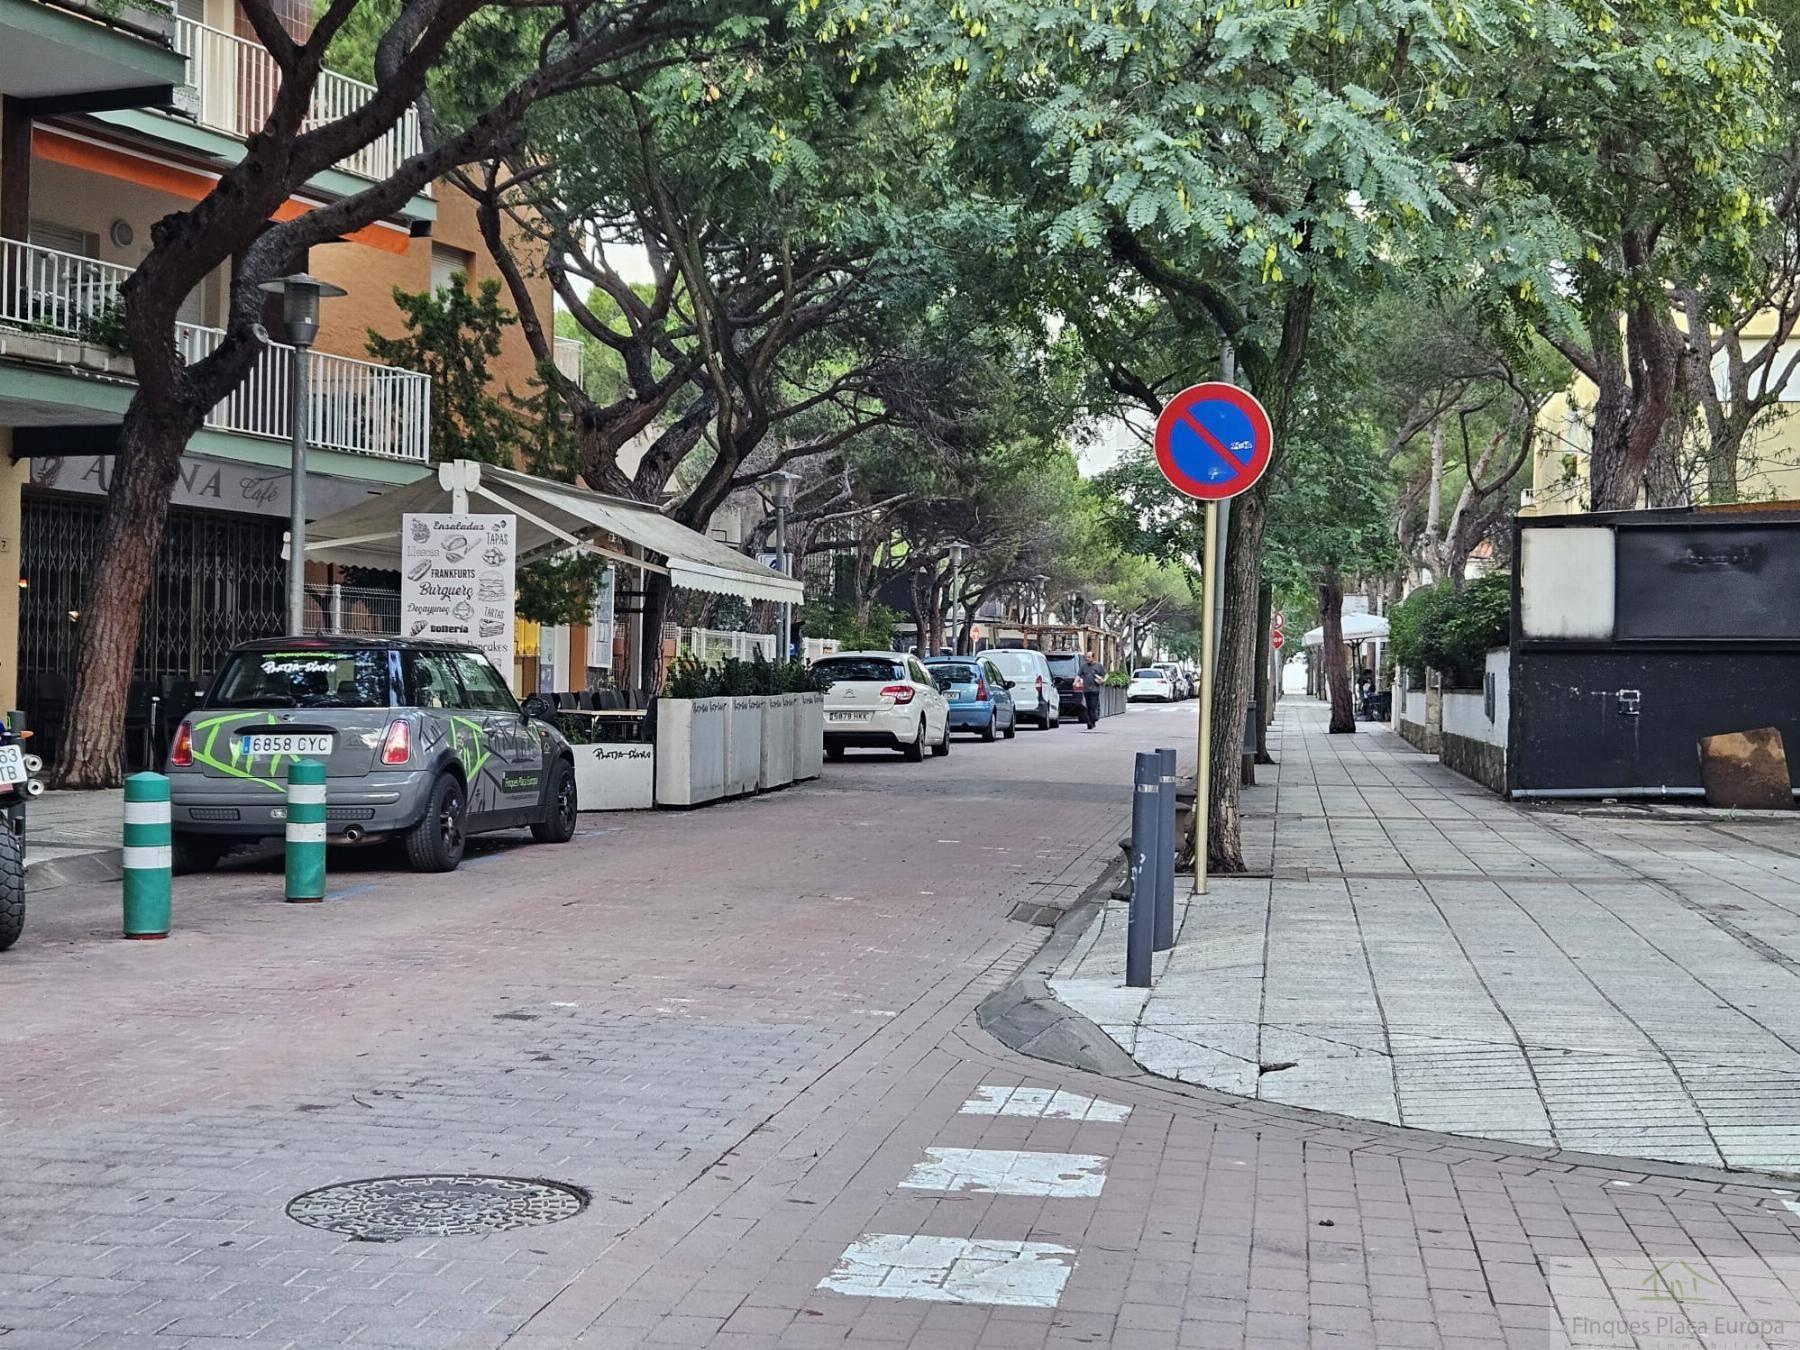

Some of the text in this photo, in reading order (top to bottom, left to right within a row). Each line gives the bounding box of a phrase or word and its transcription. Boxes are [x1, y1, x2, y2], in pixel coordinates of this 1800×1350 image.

[240, 477, 280, 508] Café
[433, 520, 485, 531] Ensaladas
[486, 532, 509, 545] TAPAS
[431, 568, 476, 579] FRANKFURTS
[484, 606, 505, 620] TARTAS
[253, 737, 328, 752] 6858 CYC
